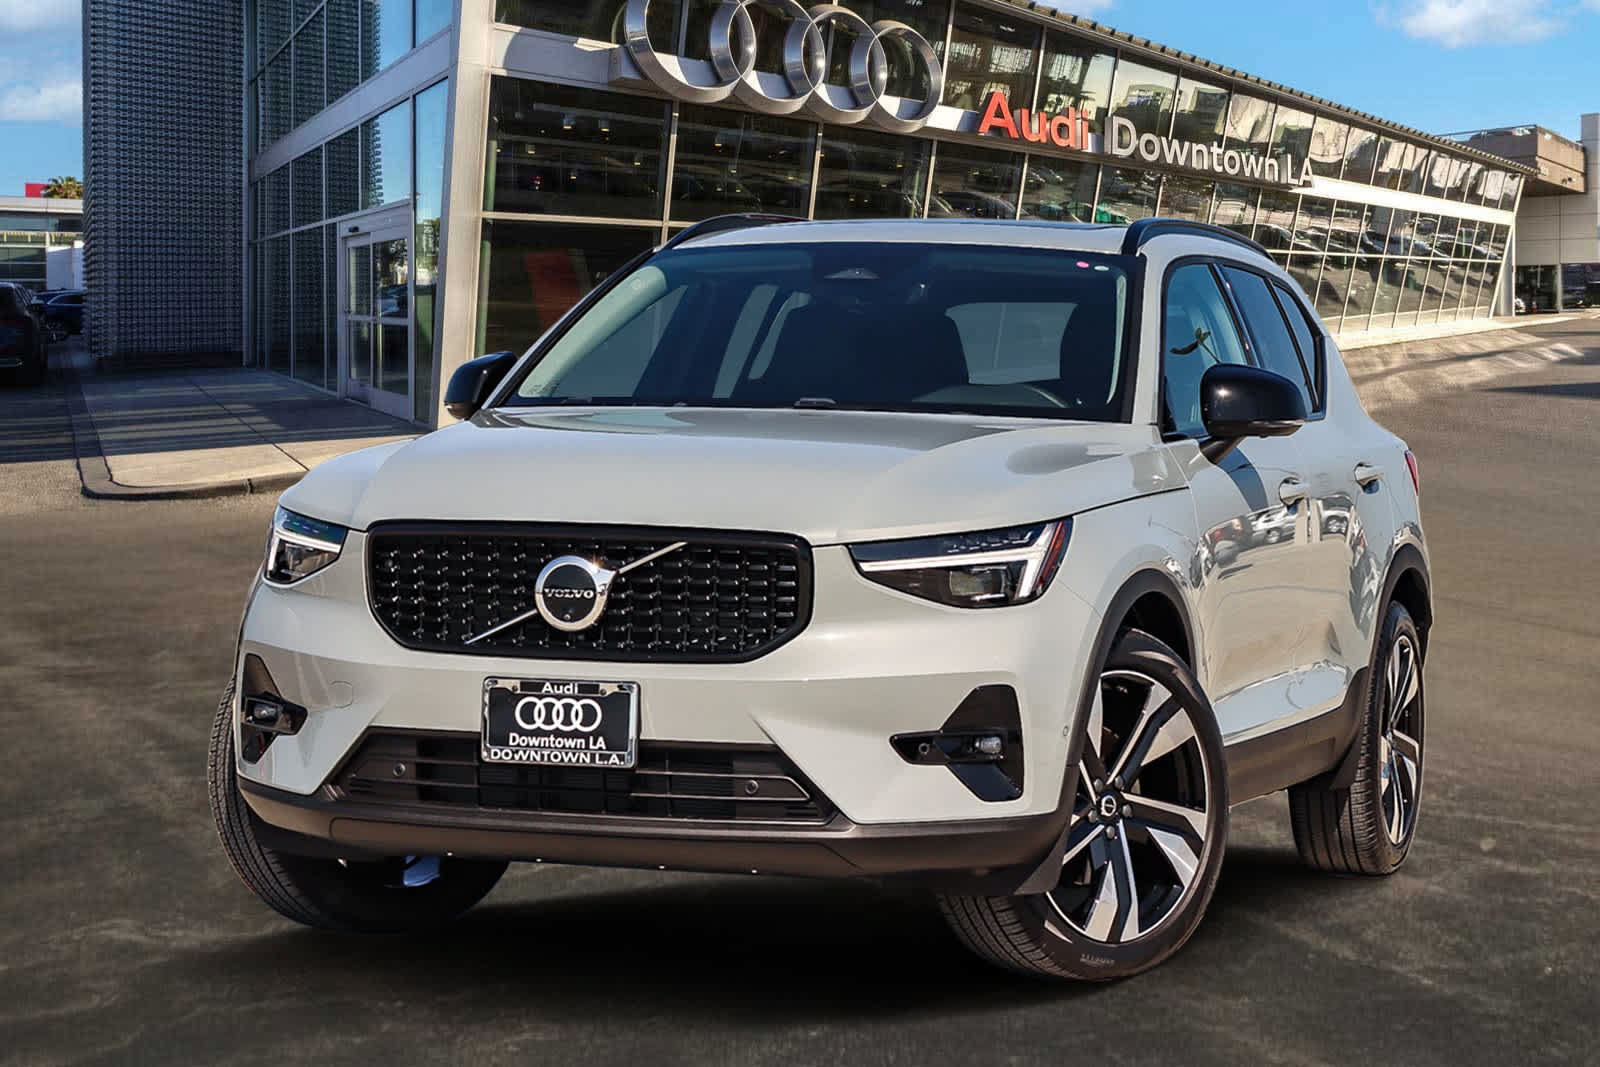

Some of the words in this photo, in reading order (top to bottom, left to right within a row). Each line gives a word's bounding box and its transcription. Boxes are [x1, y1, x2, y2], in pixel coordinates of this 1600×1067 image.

[978, 91, 1089, 150] Audi
[1108, 115, 1279, 182] Downtown
[1285, 153, 1315, 187] LA
[544, 588, 594, 599] VOLVO
[541, 682, 578, 695] Audi
[508, 732, 585, 749] Downtown
[589, 736, 606, 750] LA
[490, 749, 590, 764] DOWNTOWN
[595, 753, 625, 766] L.A.
